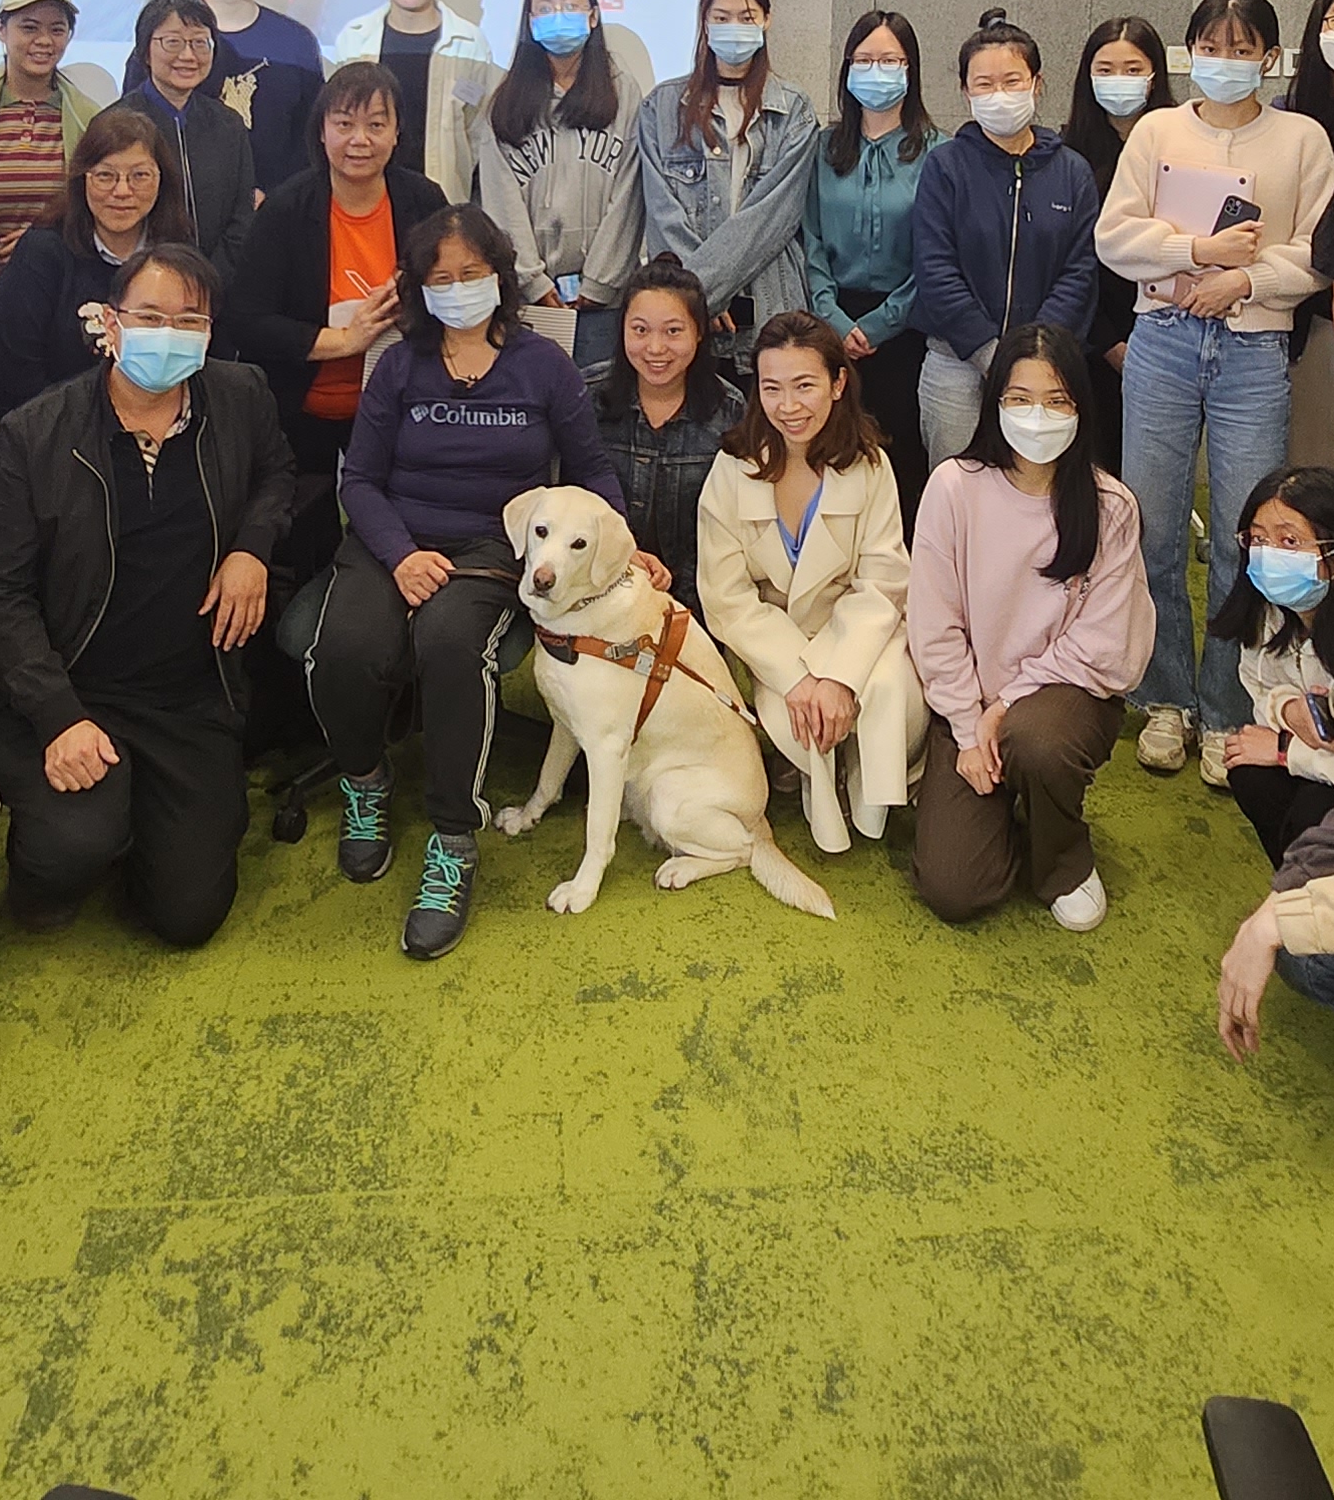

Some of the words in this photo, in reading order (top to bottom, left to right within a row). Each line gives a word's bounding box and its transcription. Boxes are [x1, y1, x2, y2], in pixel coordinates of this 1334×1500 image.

[508, 126, 559, 188] NEW
[576, 127, 624, 179] YOR
[429, 402, 528, 427] Columbia
